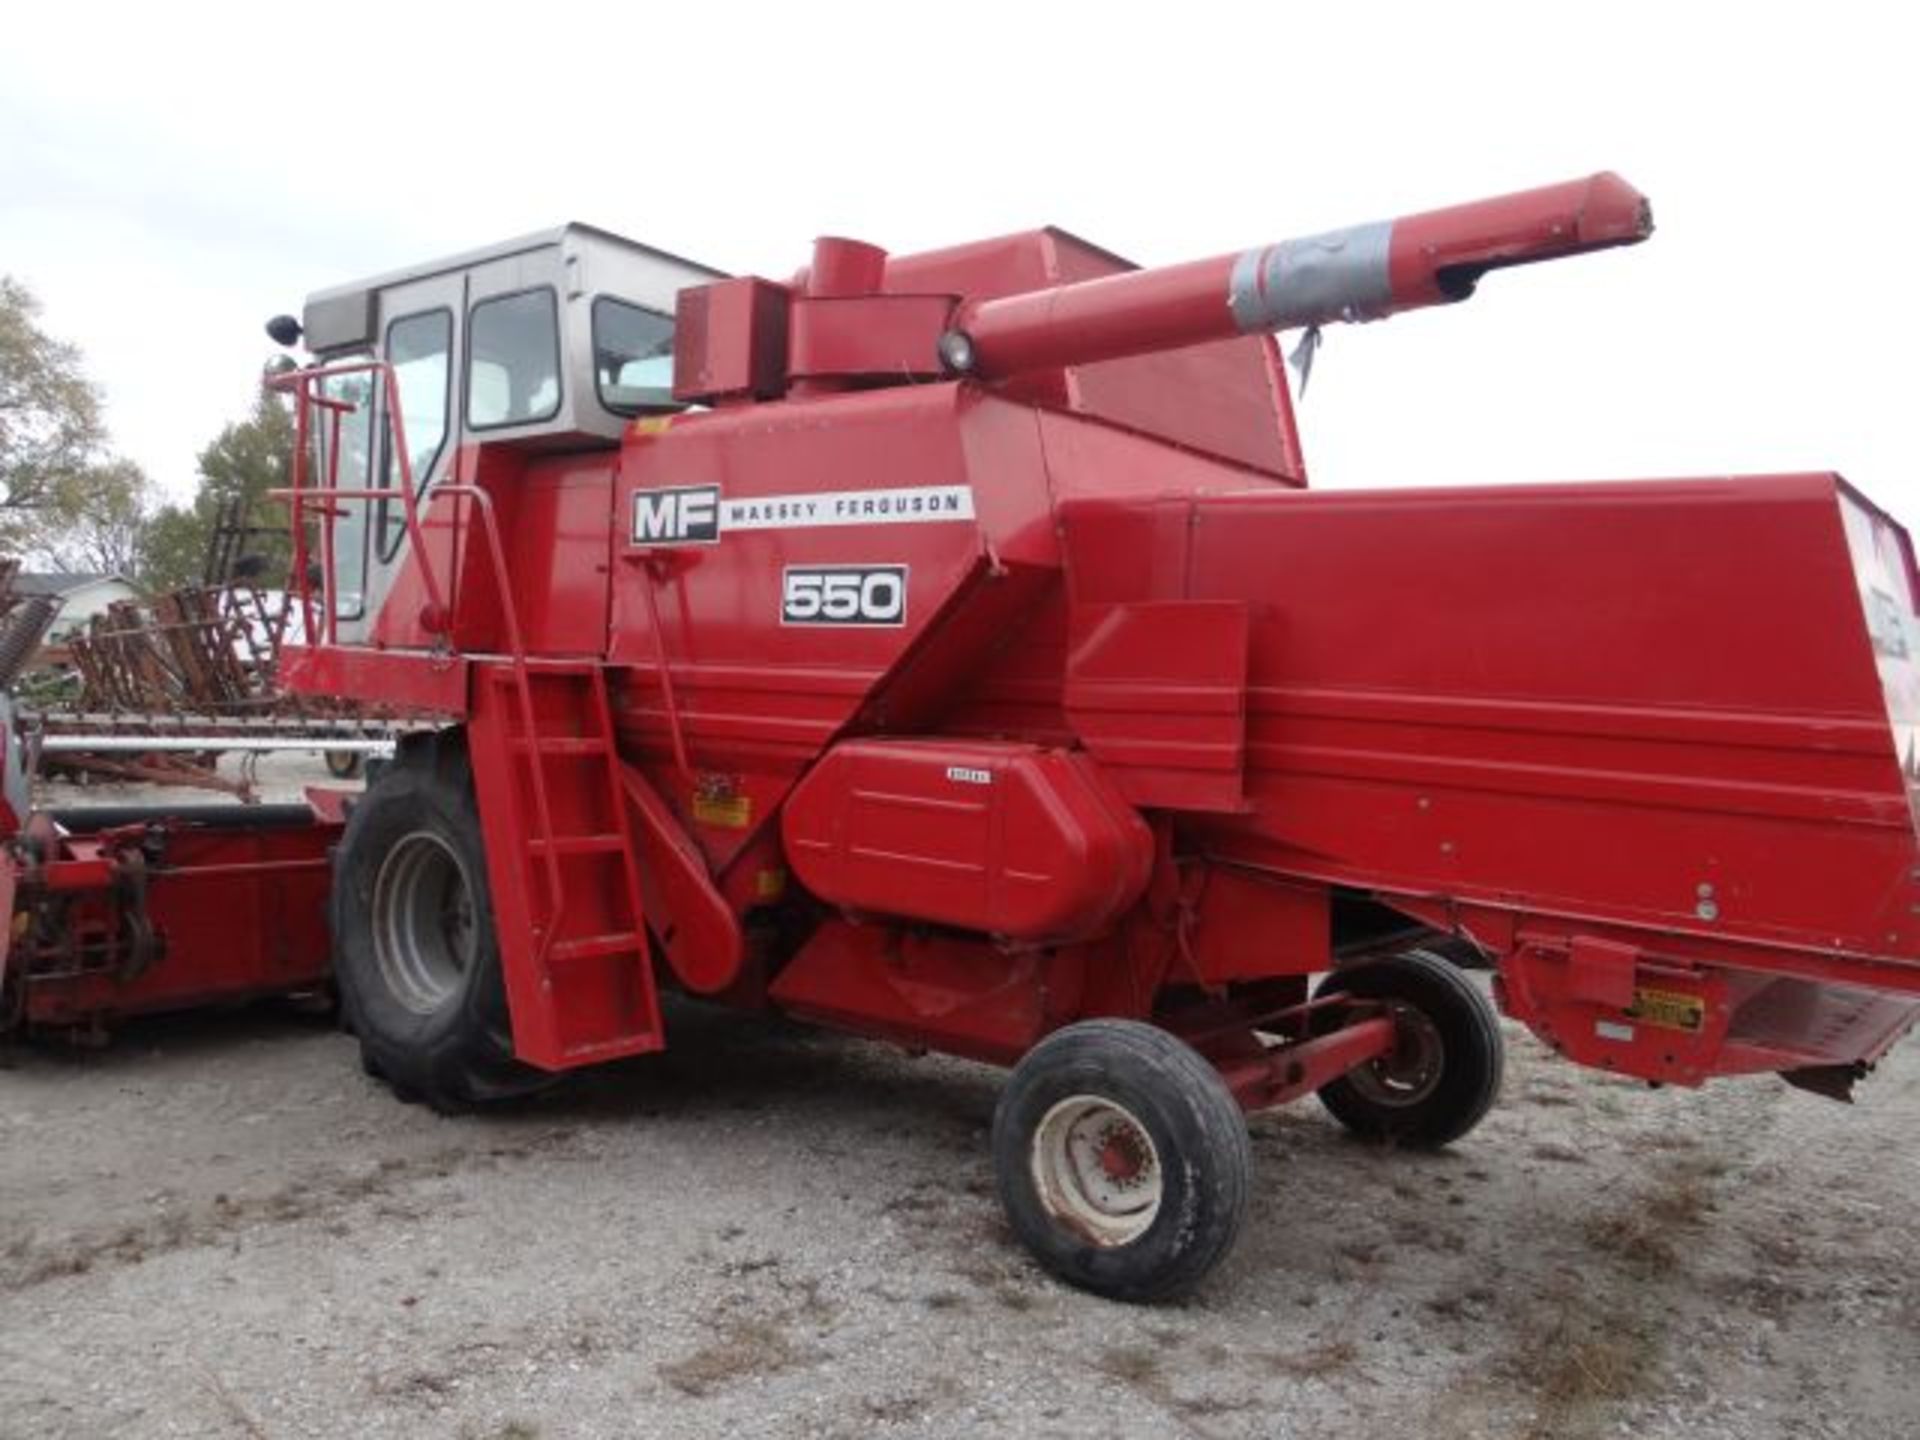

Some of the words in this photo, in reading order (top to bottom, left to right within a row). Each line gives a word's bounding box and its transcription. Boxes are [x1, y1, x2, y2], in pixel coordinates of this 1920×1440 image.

[634, 490, 717, 539] MF
[731, 502, 817, 521] MASSEY
[835, 494, 959, 516] FERGUSON
[784, 572, 902, 619] 550
